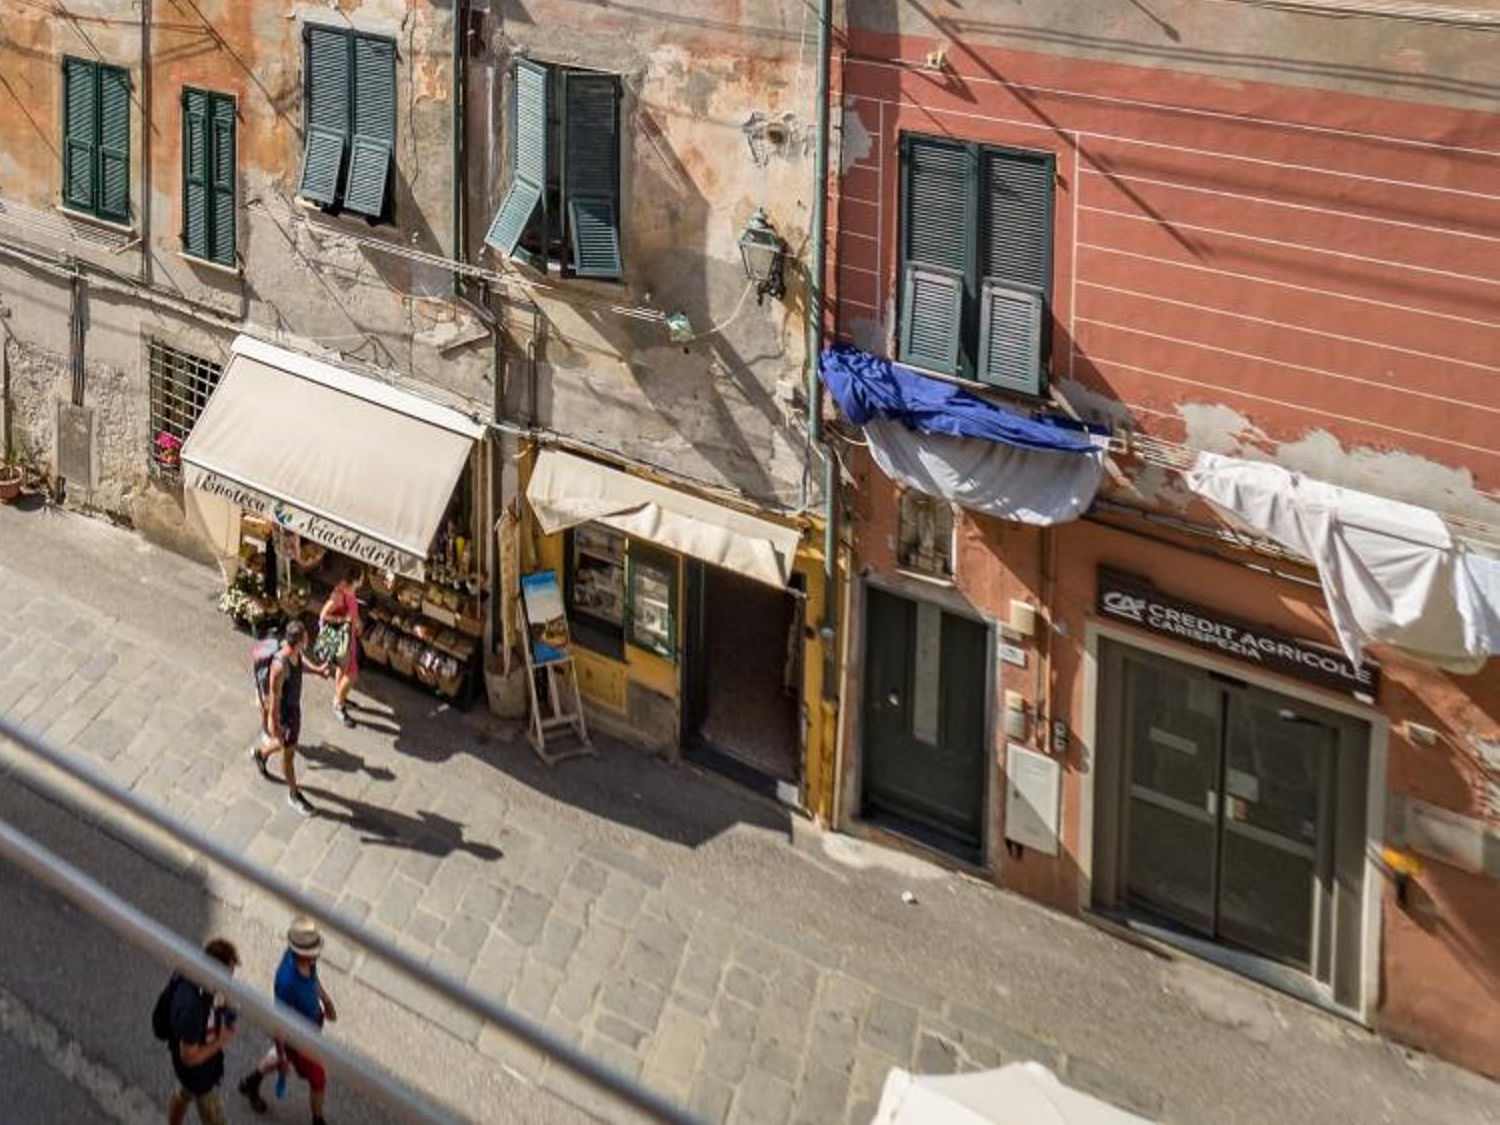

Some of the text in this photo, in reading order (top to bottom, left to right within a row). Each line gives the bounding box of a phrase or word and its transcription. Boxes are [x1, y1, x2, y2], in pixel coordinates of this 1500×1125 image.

[197, 473, 265, 513] Enoteca
[1148, 616, 1262, 661] CARISPEZIA
[1239, 632, 1372, 684] AGRICOLE
